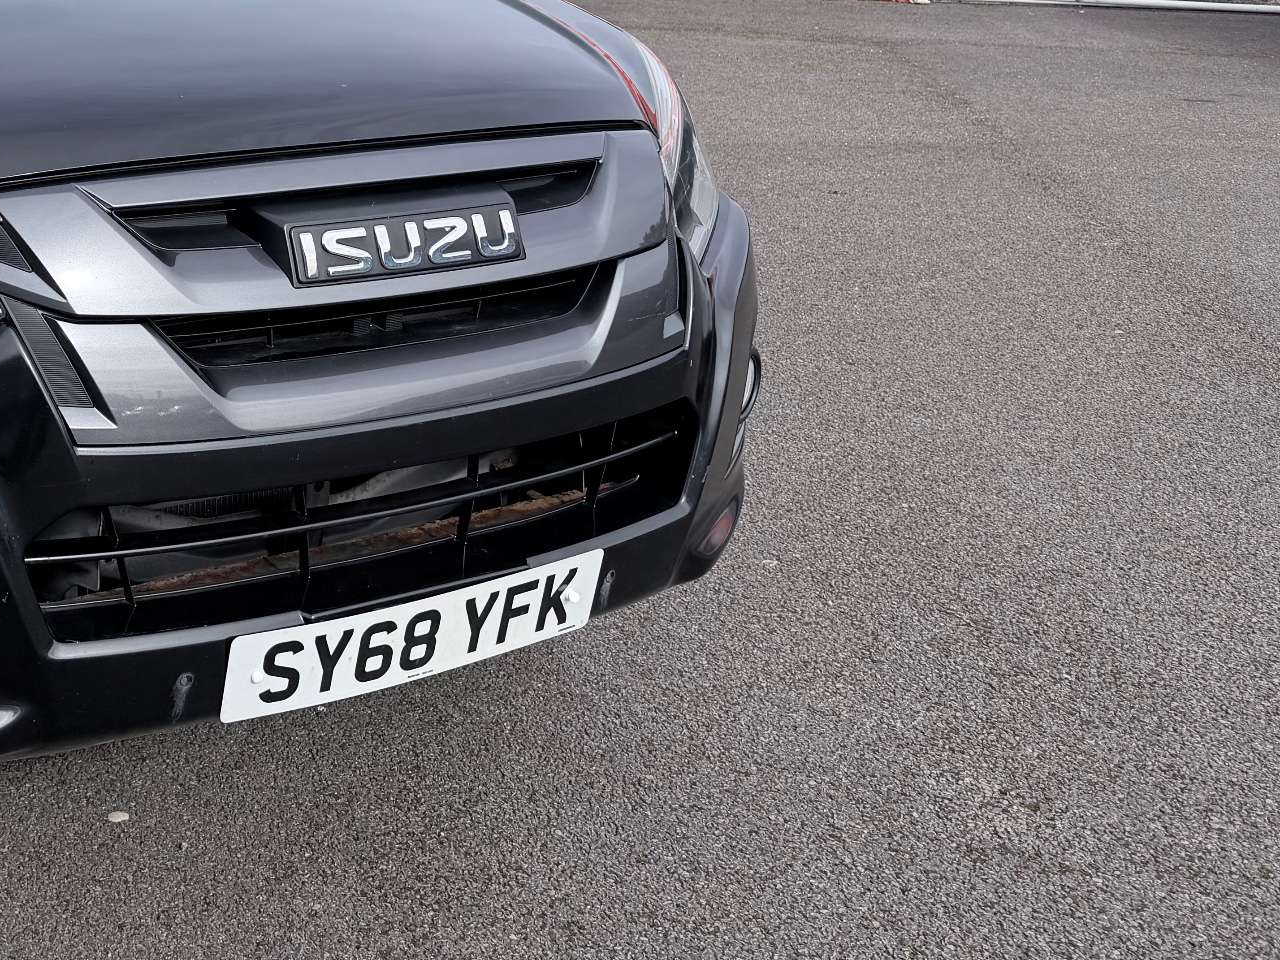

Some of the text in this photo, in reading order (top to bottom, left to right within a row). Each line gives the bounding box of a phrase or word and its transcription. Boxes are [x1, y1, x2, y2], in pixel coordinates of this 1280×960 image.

[299, 209, 517, 279] ISUZU
[258, 567, 579, 703] SY68 YFK
